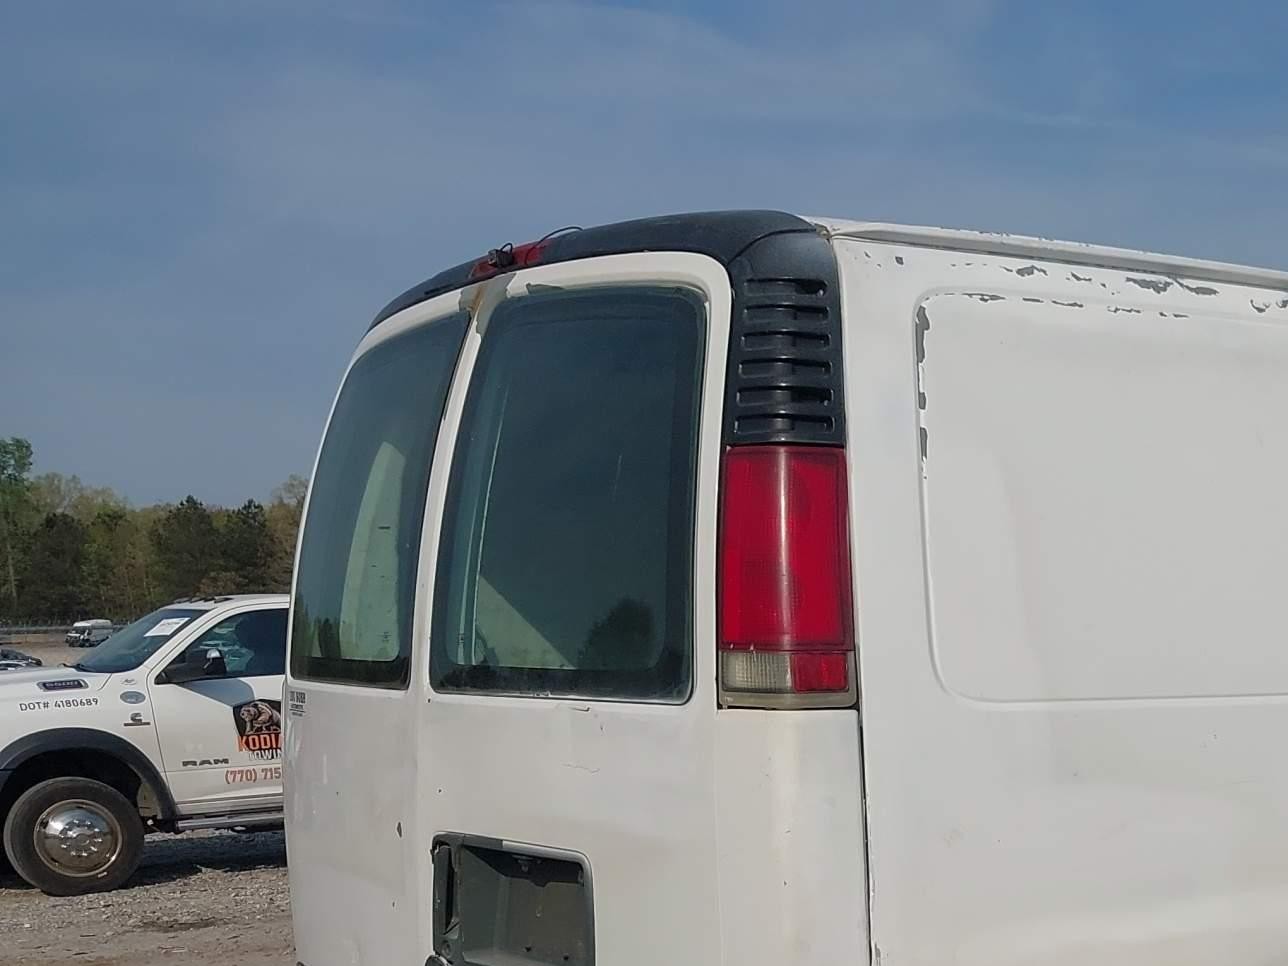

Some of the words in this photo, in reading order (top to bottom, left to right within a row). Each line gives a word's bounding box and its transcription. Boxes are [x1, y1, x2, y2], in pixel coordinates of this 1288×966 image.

[19, 702, 49, 712] DOT#
[54, 698, 98, 709] 4180689
[182, 758, 229, 767] RAM
[224, 768, 258, 785] (770)
